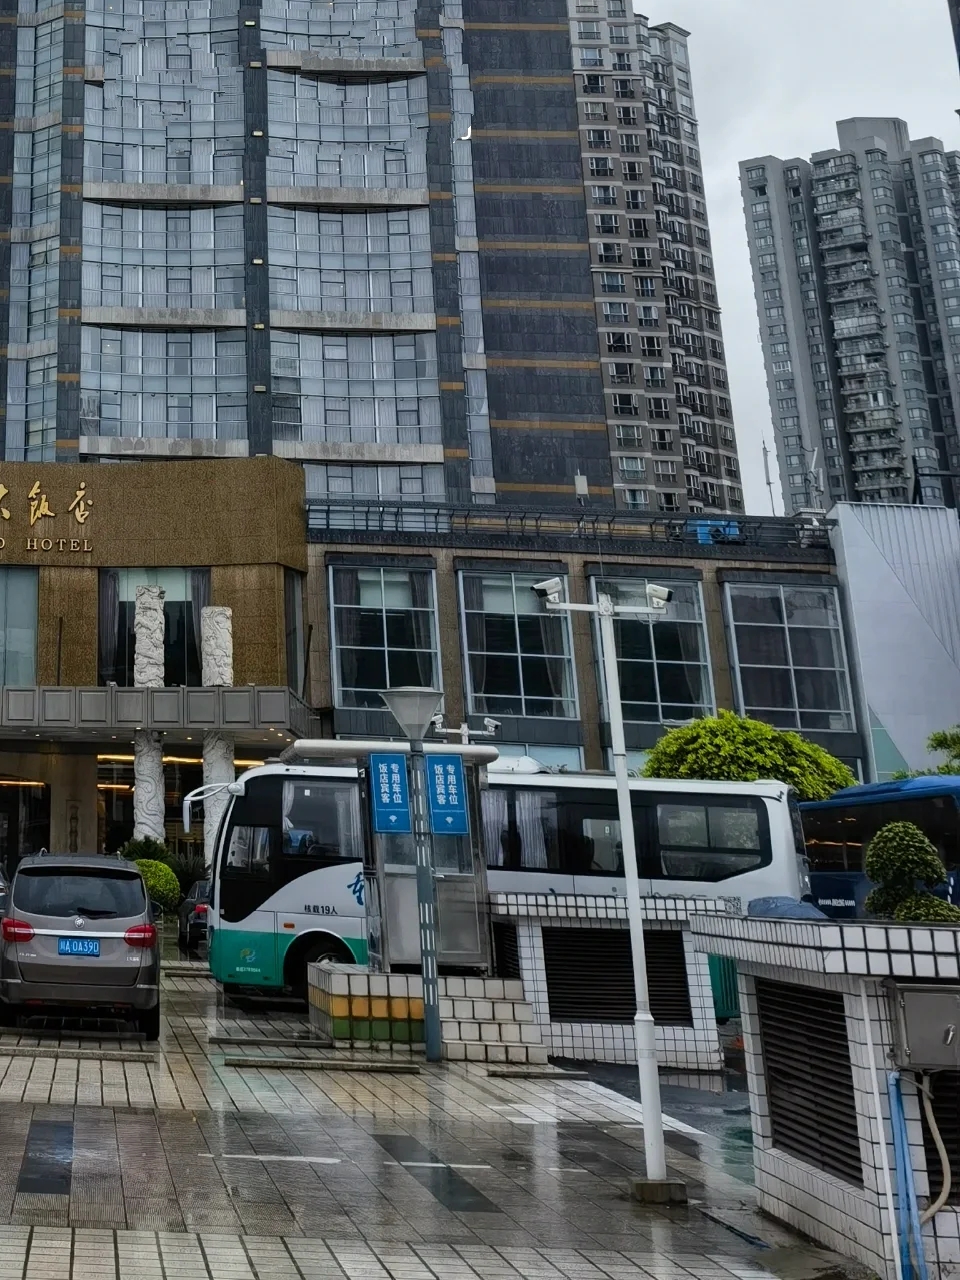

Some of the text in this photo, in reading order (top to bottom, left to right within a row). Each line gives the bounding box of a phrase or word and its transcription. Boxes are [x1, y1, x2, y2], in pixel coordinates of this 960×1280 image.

[26, 538, 93, 552] HOTEL
[378, 763, 390, 803] 饭店宾客
[390, 763, 402, 803] 专用车位
[434, 764, 446, 805] 饭店宾客
[446, 764, 459, 805] 专用车位
